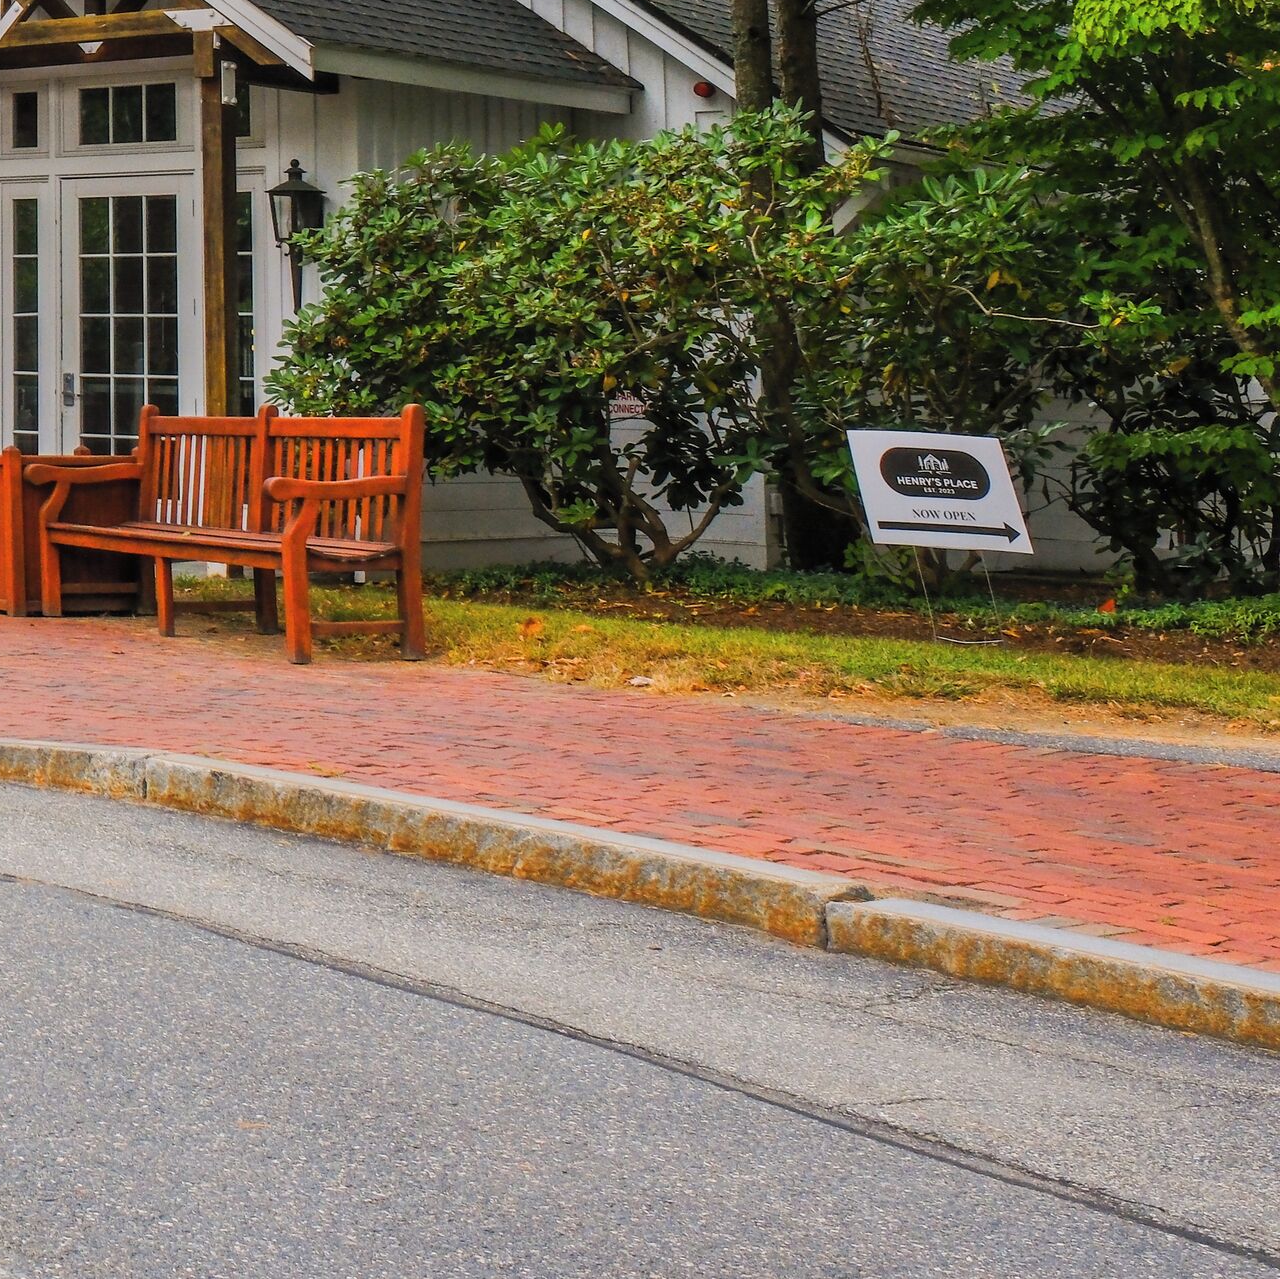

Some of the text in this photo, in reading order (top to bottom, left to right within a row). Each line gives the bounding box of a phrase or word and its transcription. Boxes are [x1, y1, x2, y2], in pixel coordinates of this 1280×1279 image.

[896, 476, 978, 489] HENRY'S PLACE
[912, 508, 976, 521] NOW OPEN
